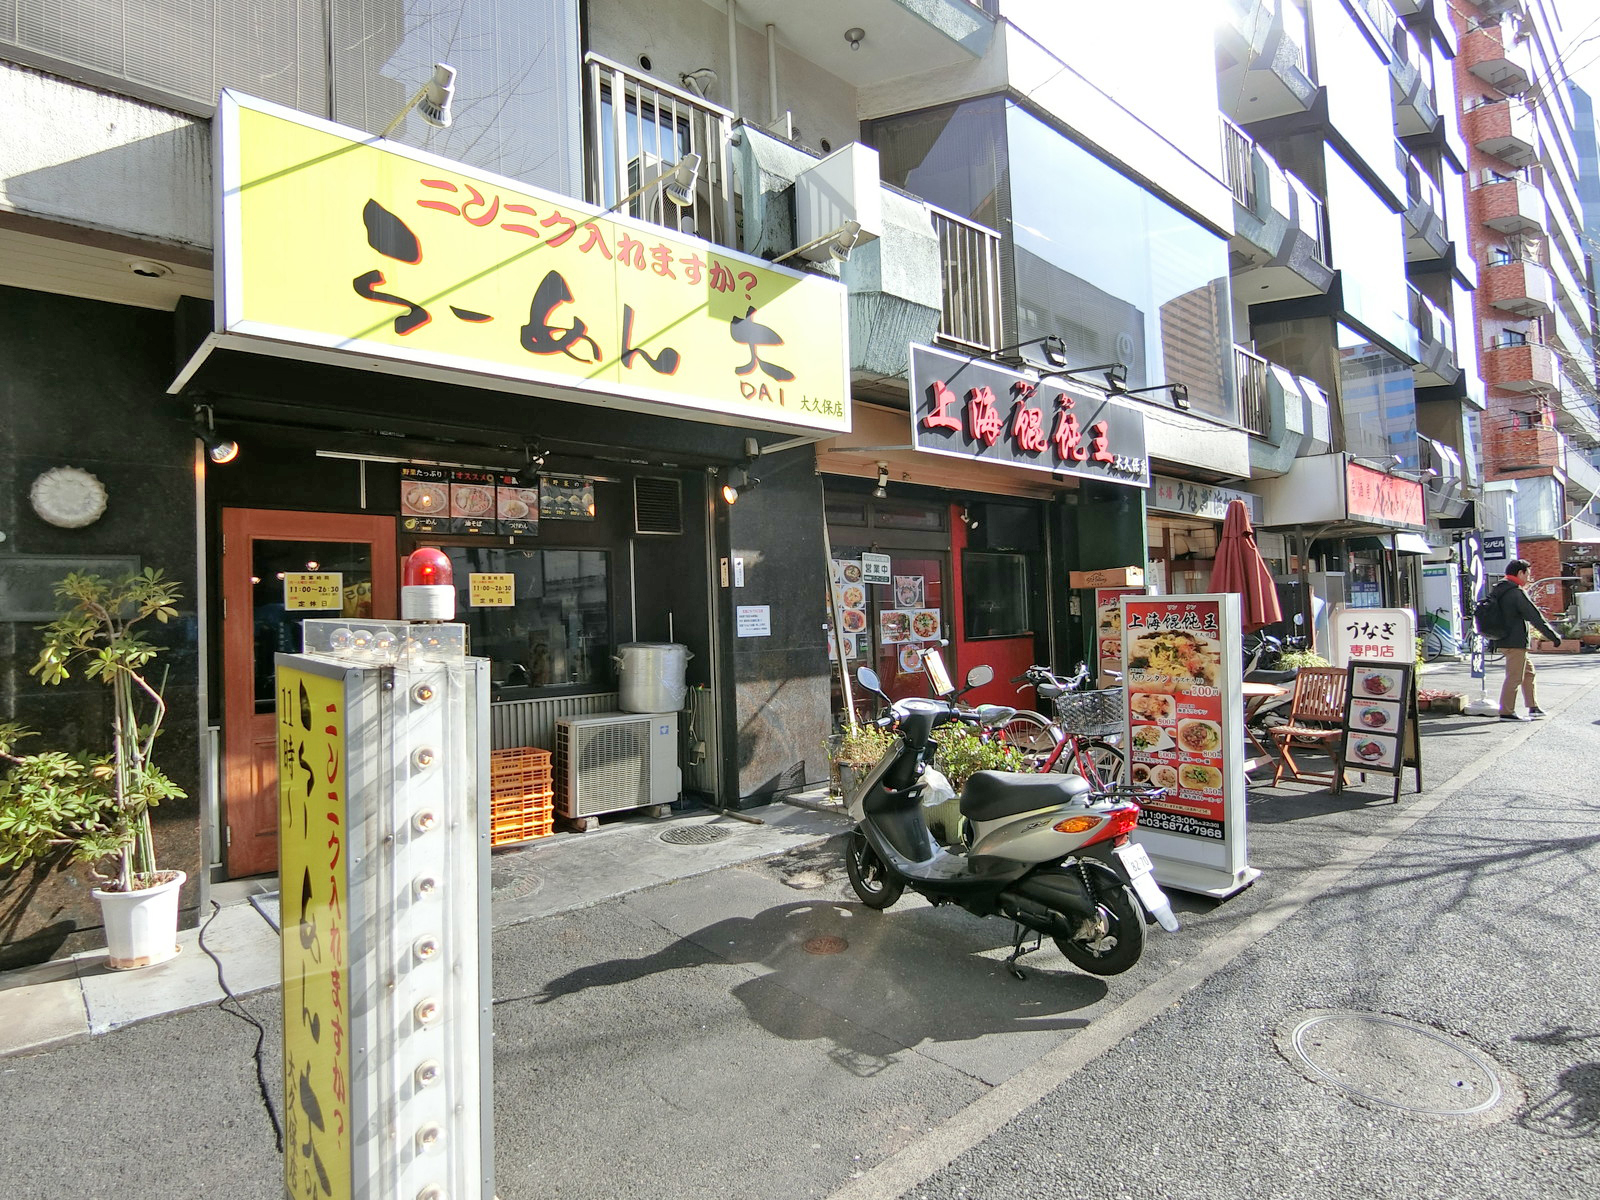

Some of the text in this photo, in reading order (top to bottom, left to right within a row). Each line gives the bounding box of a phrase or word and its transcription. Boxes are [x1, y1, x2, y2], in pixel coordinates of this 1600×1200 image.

[739, 380, 785, 407] DAI
[800, 394, 843, 417] 大久保店
[864, 563, 889, 575] 営業中
[1101, 598, 1120, 607] 上海
[1346, 621, 1397, 640] うなぎ
[1349, 644, 1395, 658] 専門店
[1138, 817, 1223, 838] el:03-6874-7968
